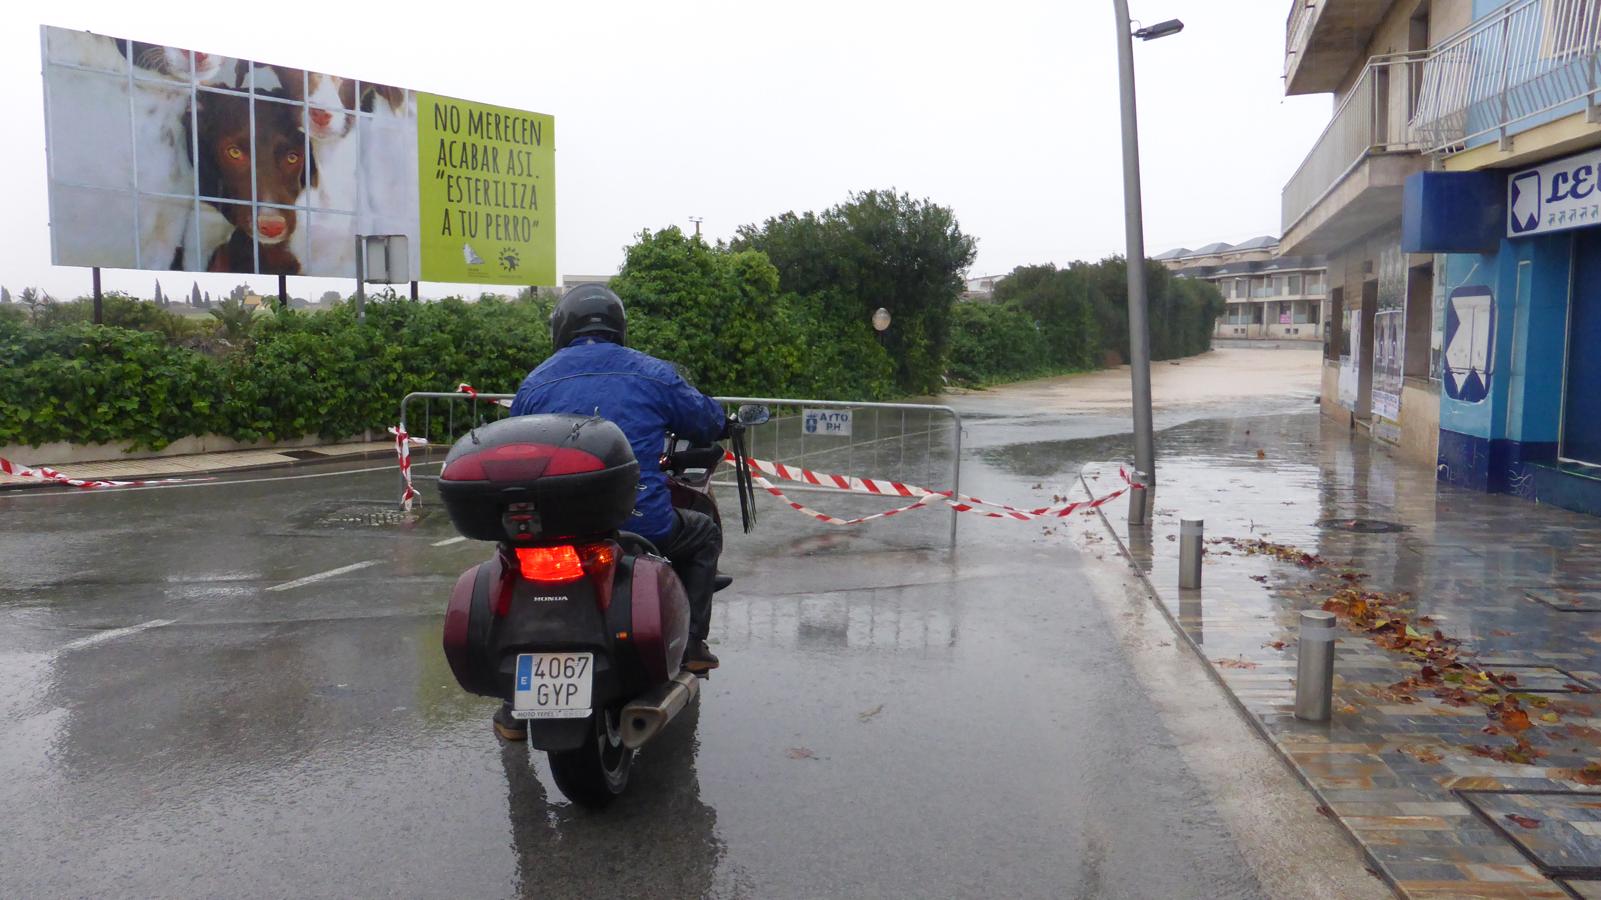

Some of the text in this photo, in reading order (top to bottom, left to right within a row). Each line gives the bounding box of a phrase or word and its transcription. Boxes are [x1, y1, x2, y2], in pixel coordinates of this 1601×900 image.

[434, 102, 542, 146] NO MERECEN
[437, 138, 540, 179] ACABAR ASI.
[436, 169, 538, 211] "ESTERILIZA
[1545, 162, 1601, 204] LE
[441, 208, 539, 243] A TU PERRO"
[819, 412, 849, 422] AYTO
[520, 676, 528, 685] E
[534, 656, 590, 680] 4067
[537, 683, 578, 706] GYP
